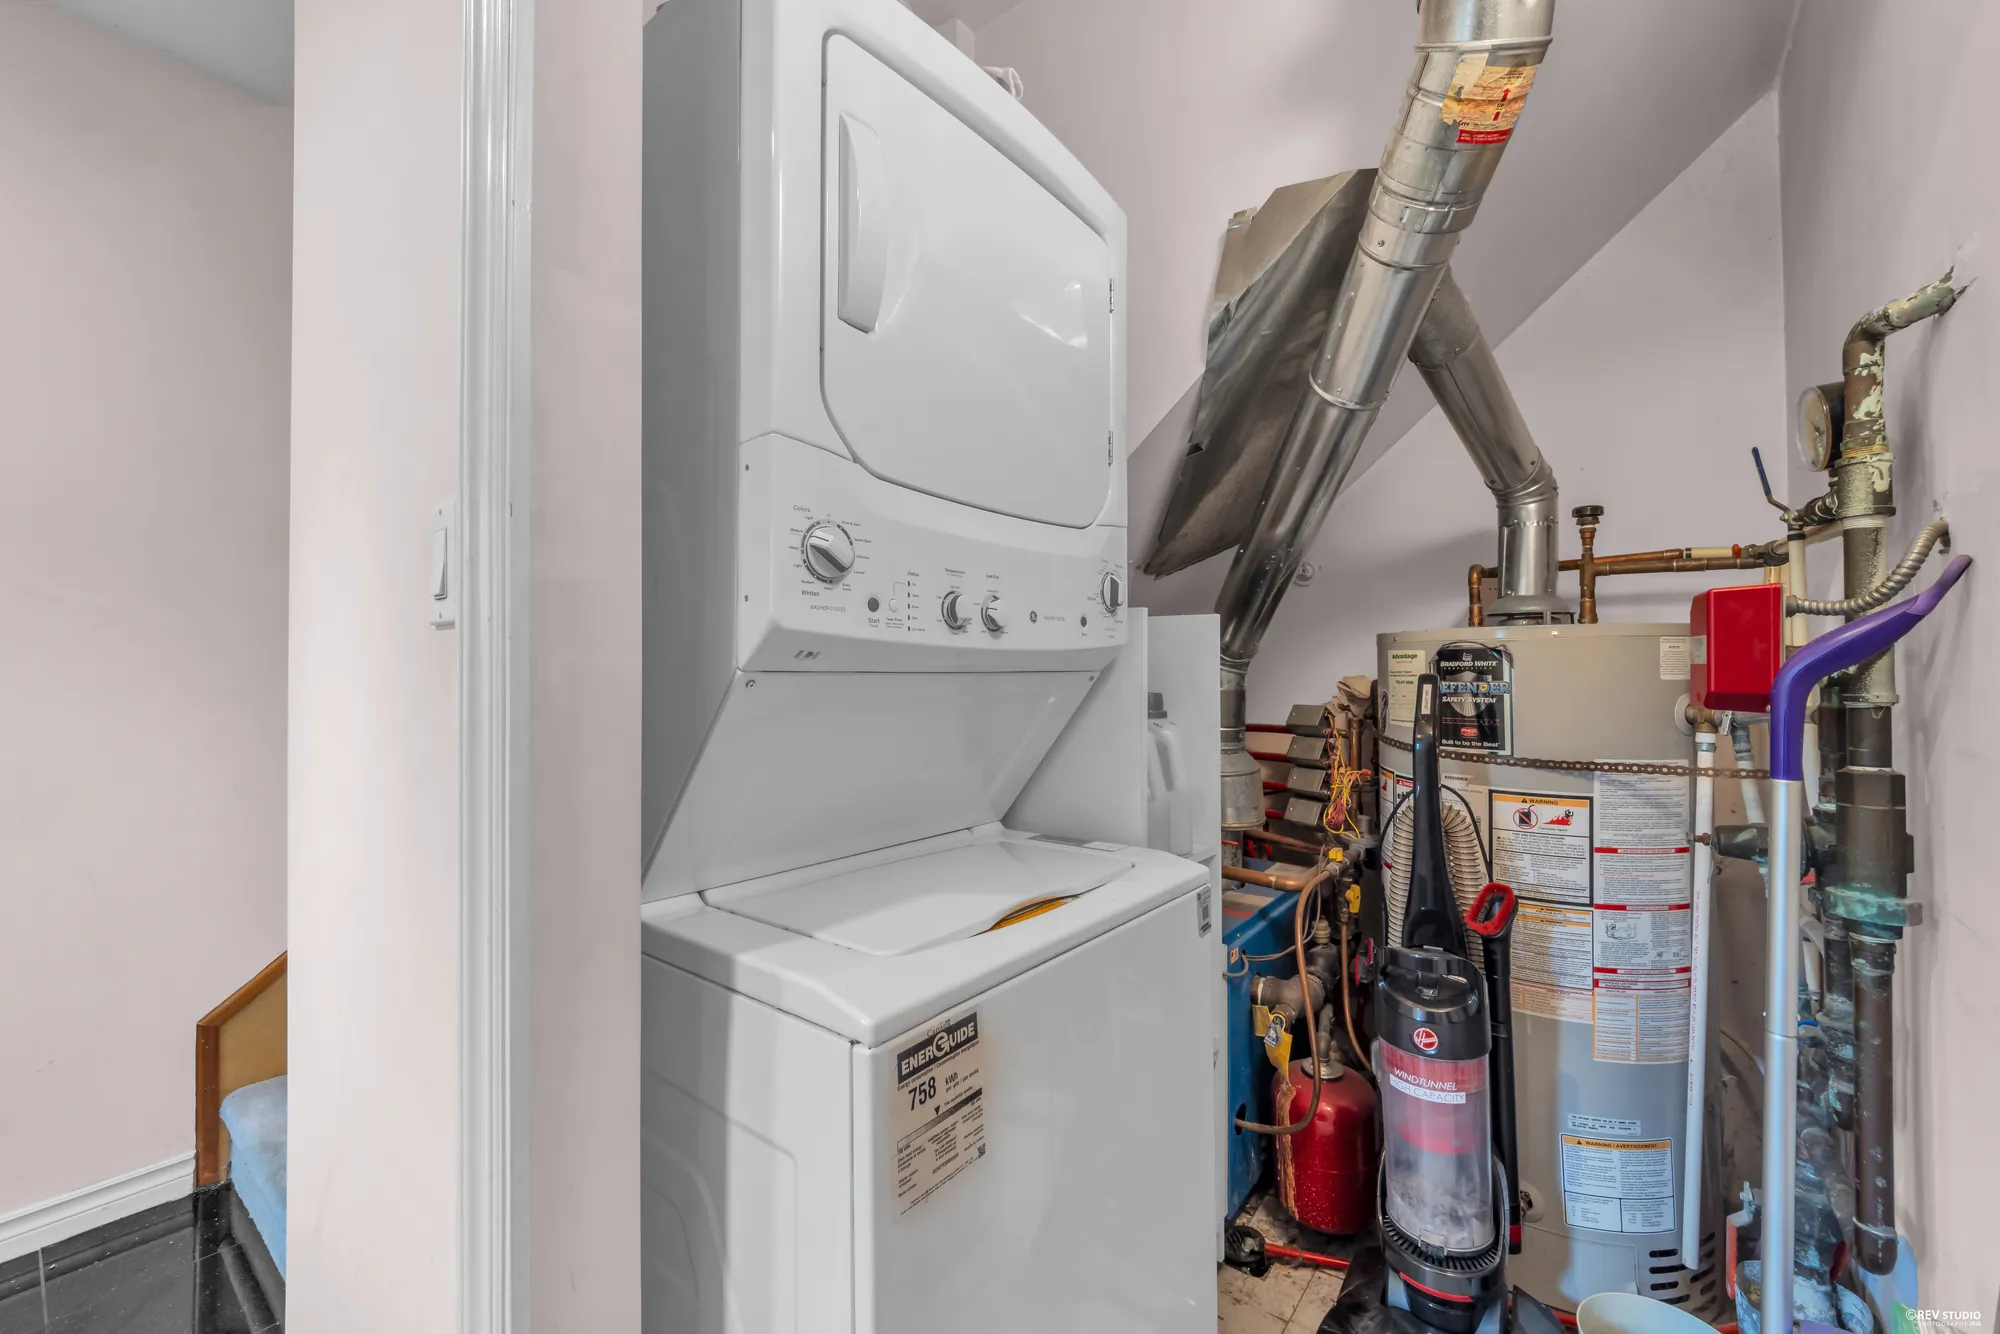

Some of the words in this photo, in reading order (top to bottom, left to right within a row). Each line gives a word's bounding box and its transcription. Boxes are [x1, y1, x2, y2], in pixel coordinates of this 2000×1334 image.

[793, 504, 811, 513] Colors
[906, 570, 920, 578] Status
[801, 589, 820, 598] Whites
[809, 604, 829, 612] WASHER
[867, 617, 881, 625] Start
[1392, 652, 1419, 661] Advantage
[1467, 696, 1497, 704] SYSTEM
[1528, 797, 1559, 806] WARNING
[901, 1021, 976, 1076] ENERGUIDE
[945, 1071, 959, 1086] kWh
[1394, 1067, 1458, 1091] WINDTUNNEL
[908, 1076, 937, 1112] 758
[1414, 1087, 1465, 1103] CAPACITY
[1585, 1140, 1612, 1149] WARNING
